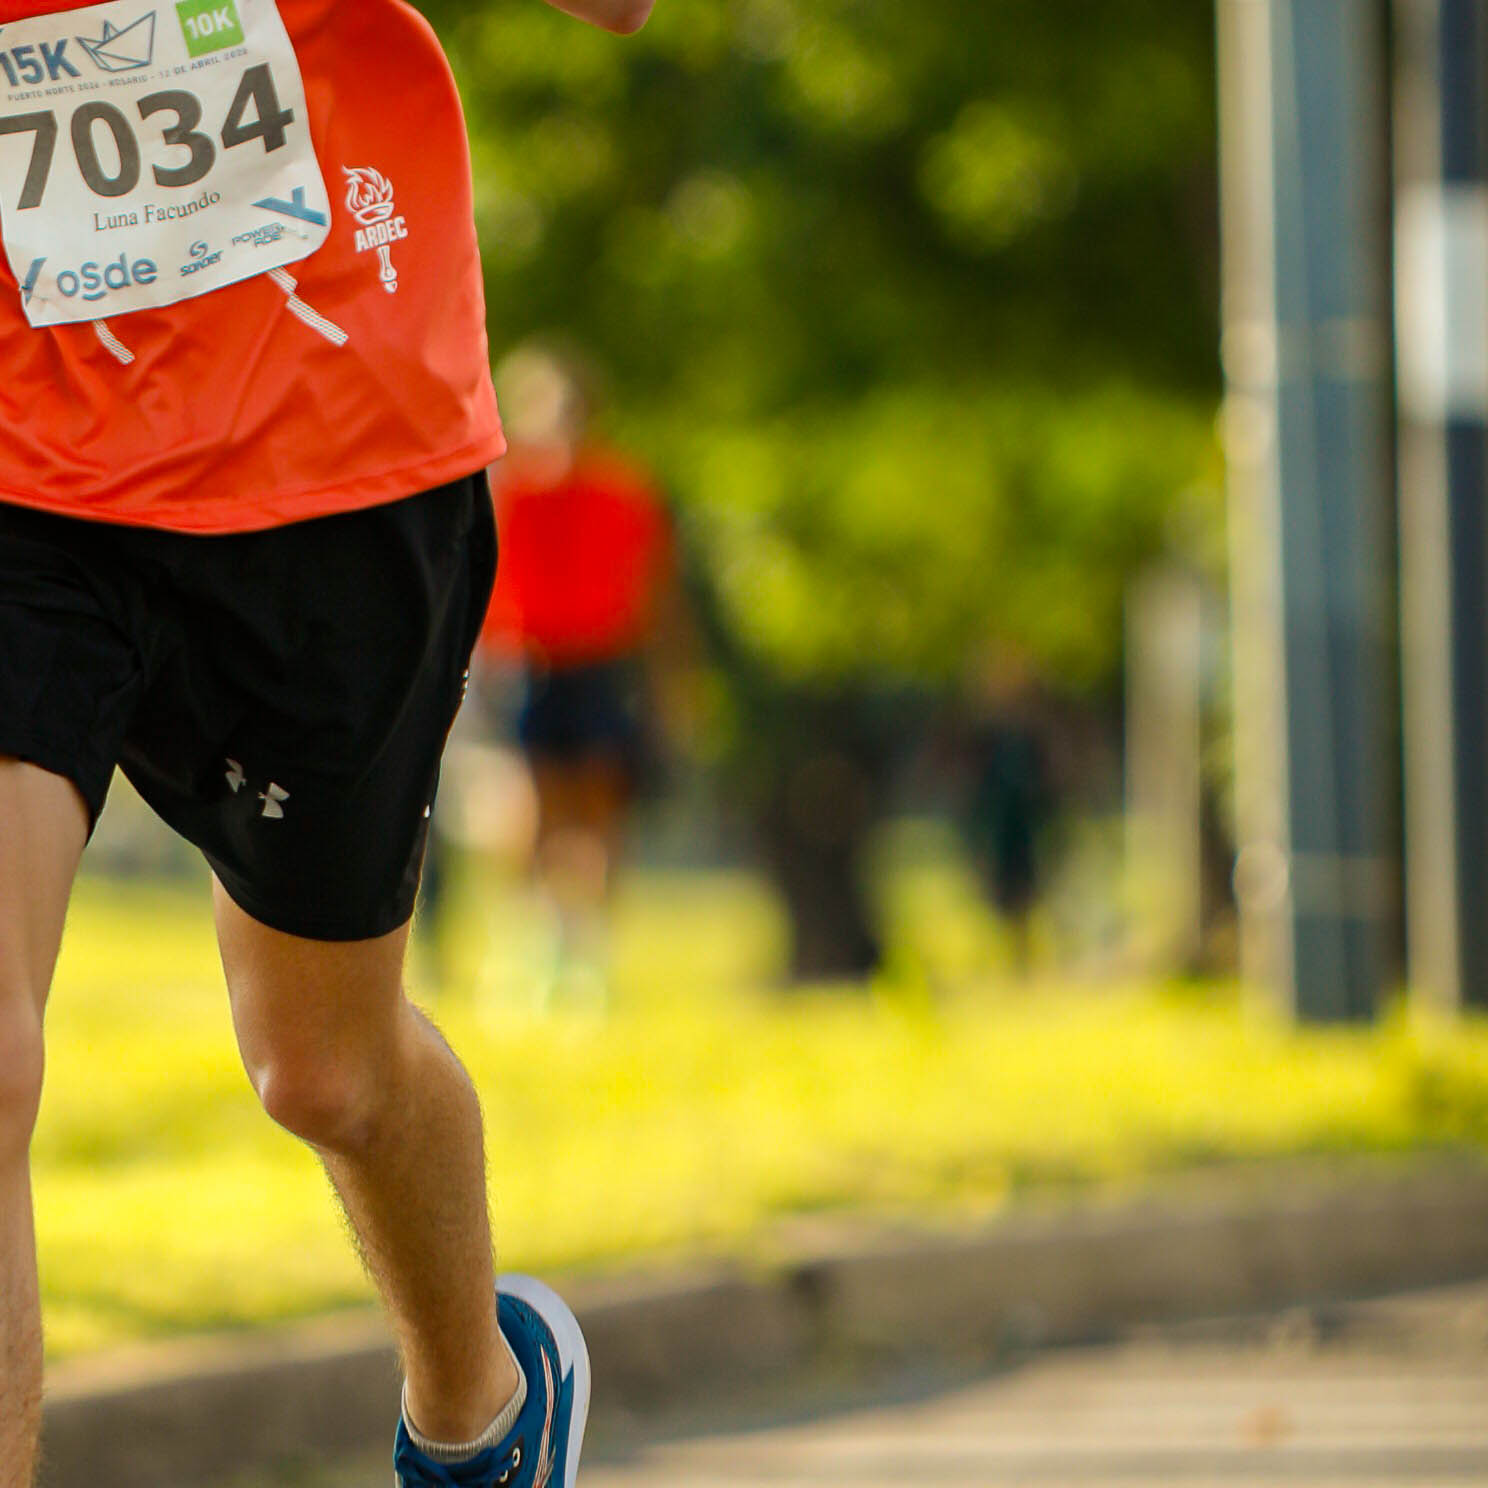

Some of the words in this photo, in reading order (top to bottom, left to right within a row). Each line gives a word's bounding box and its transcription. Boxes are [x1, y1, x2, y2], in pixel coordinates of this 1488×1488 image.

[185, 5, 234, 41] 10K
[191, 55, 221, 71] ABRIL
[93, 212, 139, 232] Luna
[143, 191, 222, 225] Facundo
[354, 215, 409, 254] ARDEC
[56, 252, 159, 300] osde
